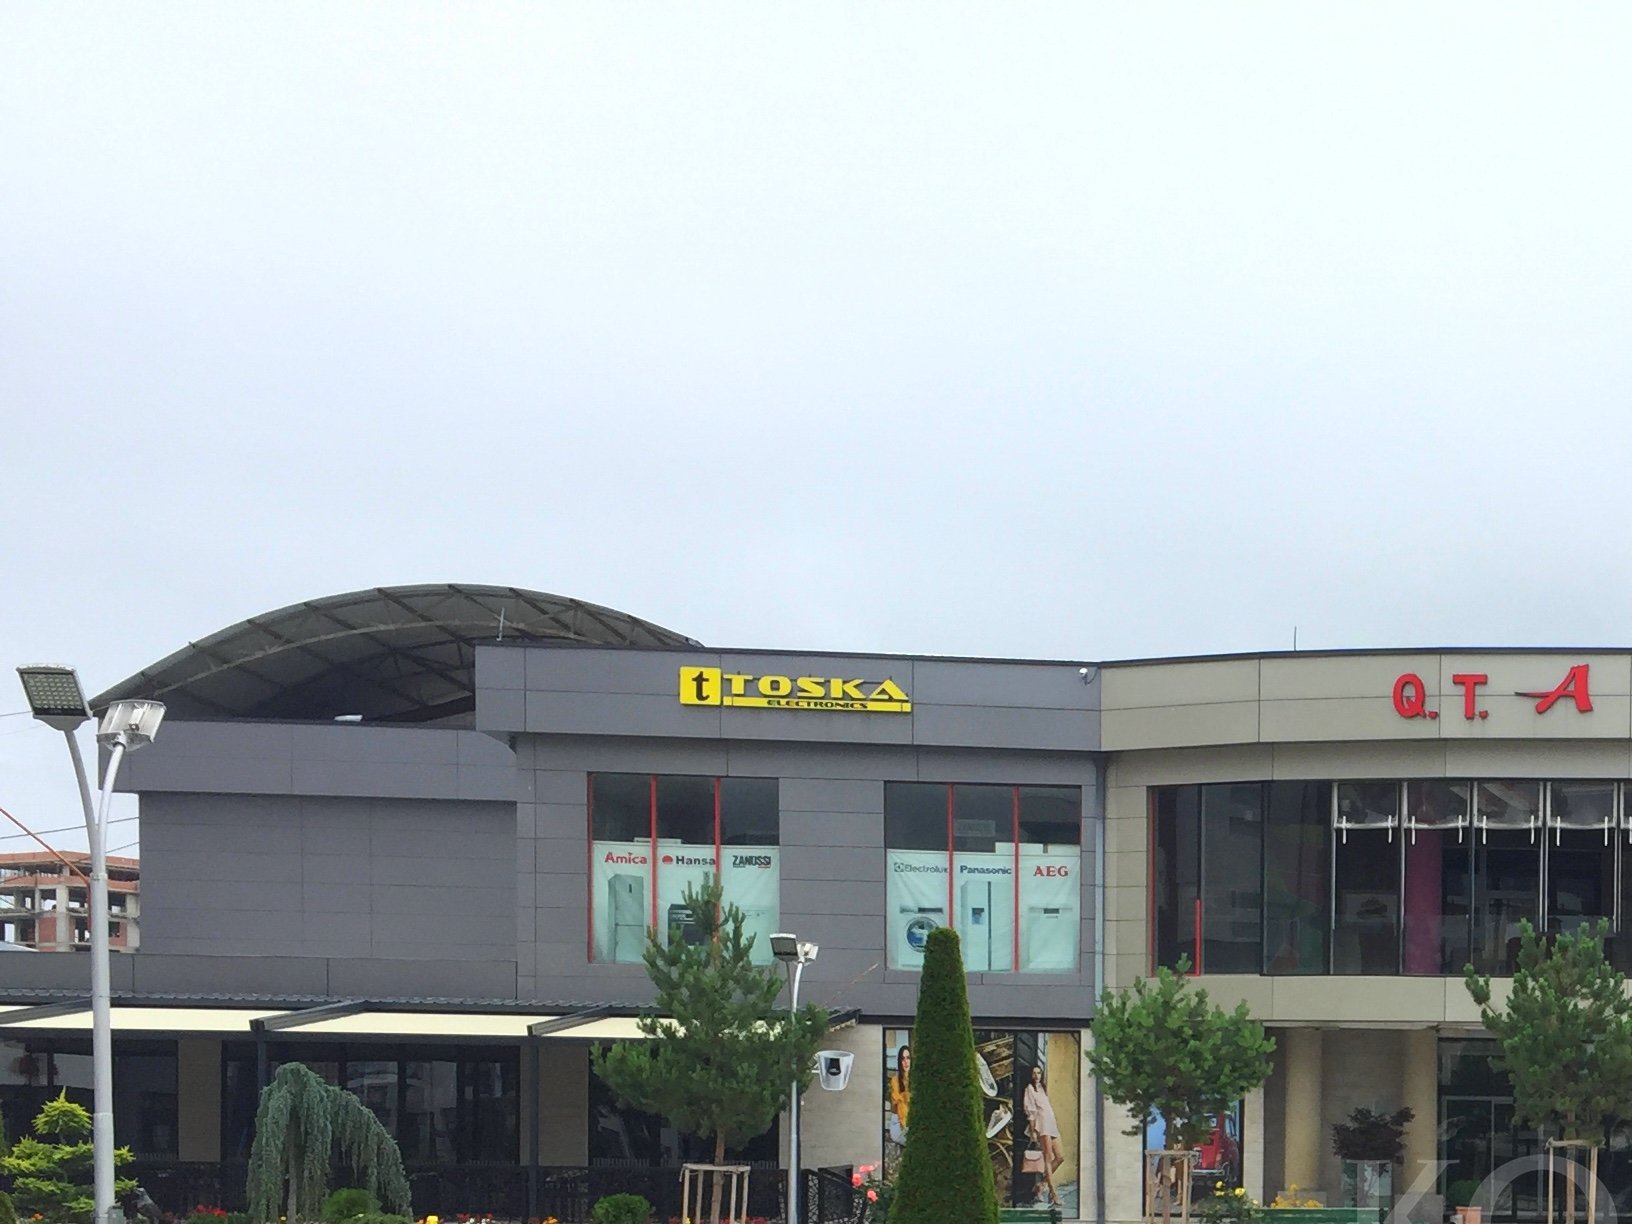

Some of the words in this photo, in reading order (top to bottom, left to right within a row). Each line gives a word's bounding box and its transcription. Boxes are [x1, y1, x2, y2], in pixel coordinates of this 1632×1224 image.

[723, 674, 909, 700] TOSKA
[766, 698, 869, 710] ELECTRONICS
[604, 851, 648, 865] Amica
[675, 855, 716, 866] Hansa
[959, 864, 1012, 875] Panasonic
[1033, 865, 1069, 878] AEG
